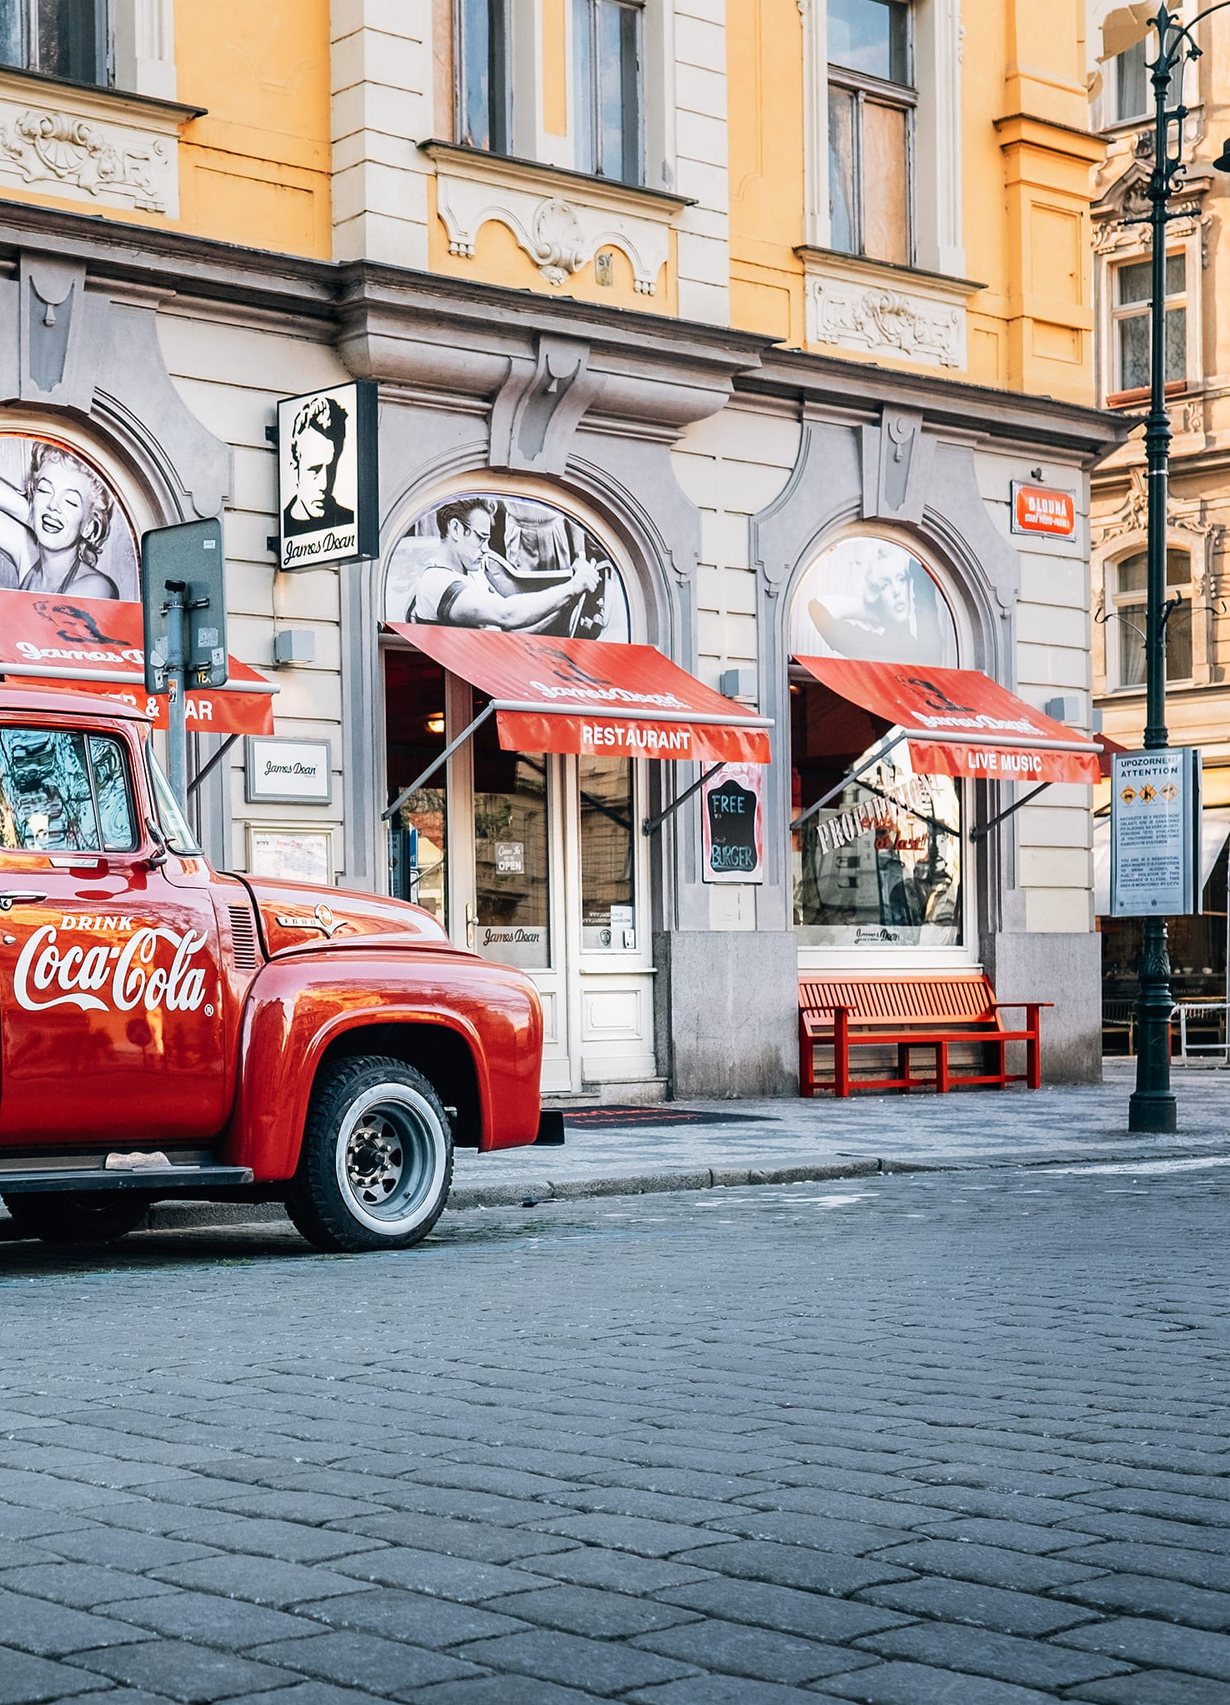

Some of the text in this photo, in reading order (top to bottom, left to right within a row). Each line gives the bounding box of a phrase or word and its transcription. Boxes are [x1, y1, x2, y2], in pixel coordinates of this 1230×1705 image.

[283, 532, 355, 565] James Dean
[15, 641, 124, 663] James
[530, 681, 610, 700] James
[146, 697, 160, 717] &
[184, 700, 214, 720] AR
[910, 711, 977, 728] James
[582, 725, 691, 750] RESTAURANT
[264, 760, 316, 776] James Dean
[968, 752, 1043, 772] LIVE MUSIC
[1121, 767, 1178, 778] ATTENTION
[712, 795, 745, 813] FREE
[711, 845, 753, 866] BURGER
[498, 861, 522, 871] OPEN
[59, 915, 133, 931] DRINK
[483, 929, 540, 946] James Dean
[13, 925, 209, 1012] Coca-Cola
